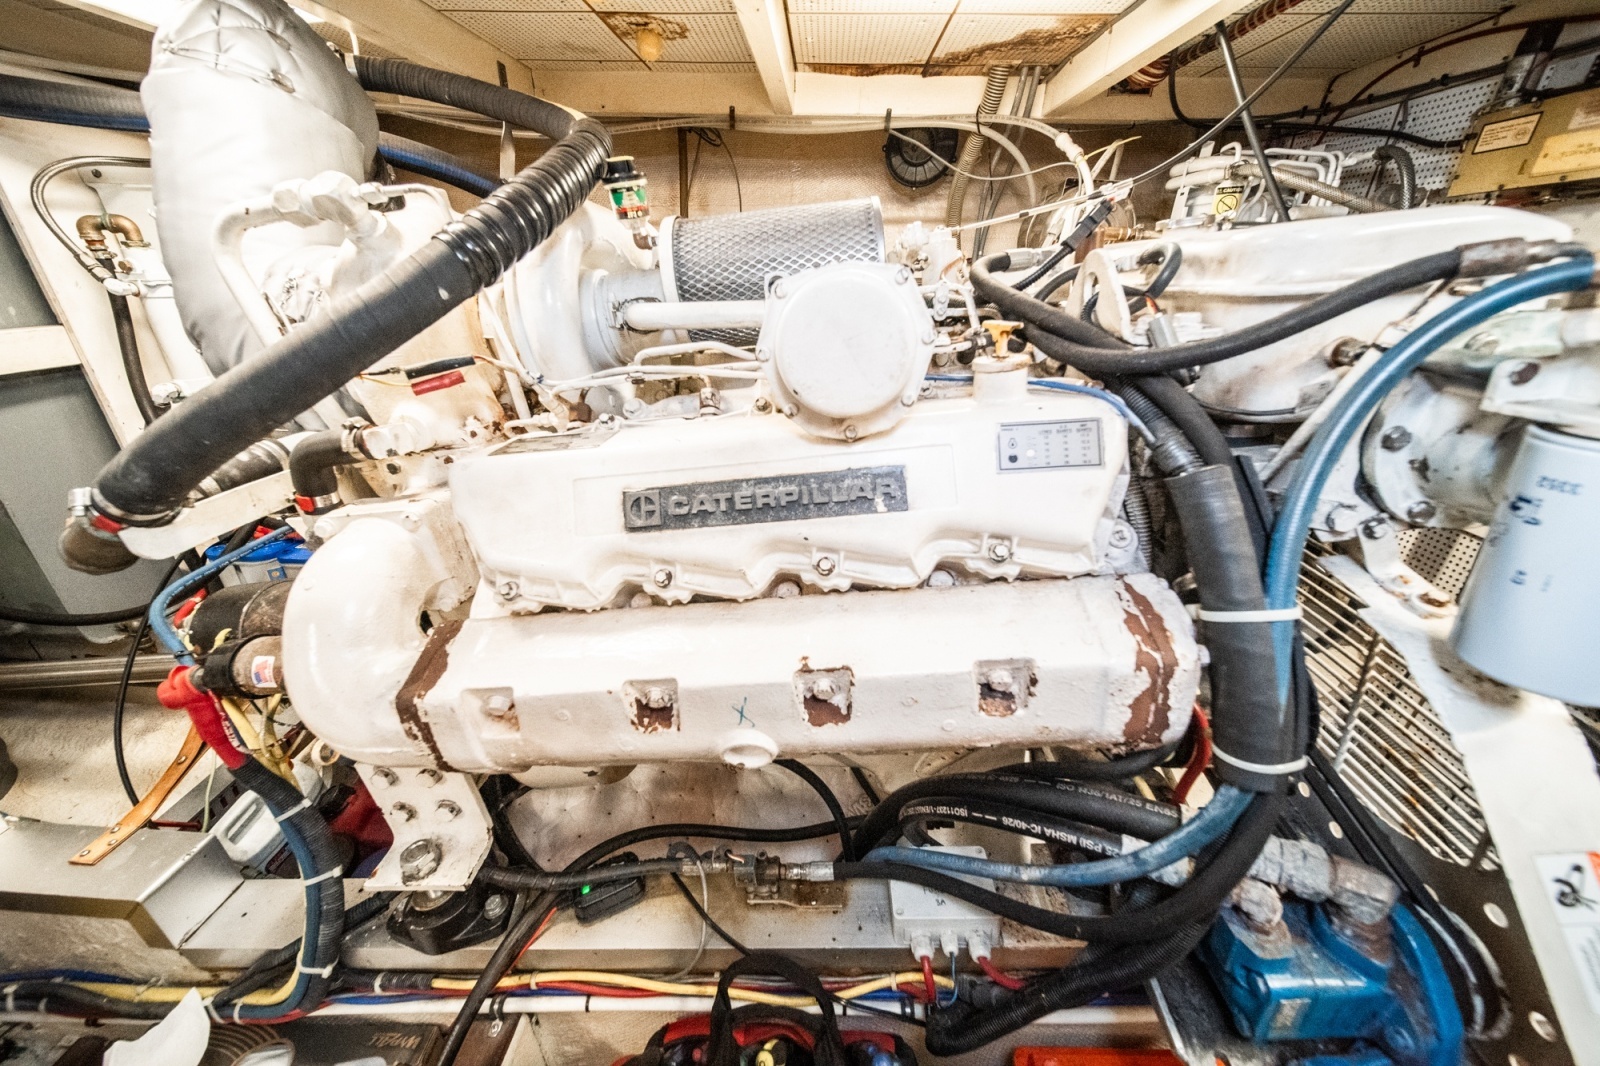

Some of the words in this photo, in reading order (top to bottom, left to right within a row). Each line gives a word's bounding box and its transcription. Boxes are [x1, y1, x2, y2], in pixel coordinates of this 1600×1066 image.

[667, 478, 899, 517] CATERPILLAR
[1001, 815, 1042, 834] IC-40/26
[1043, 826, 1077, 845] MSHA
